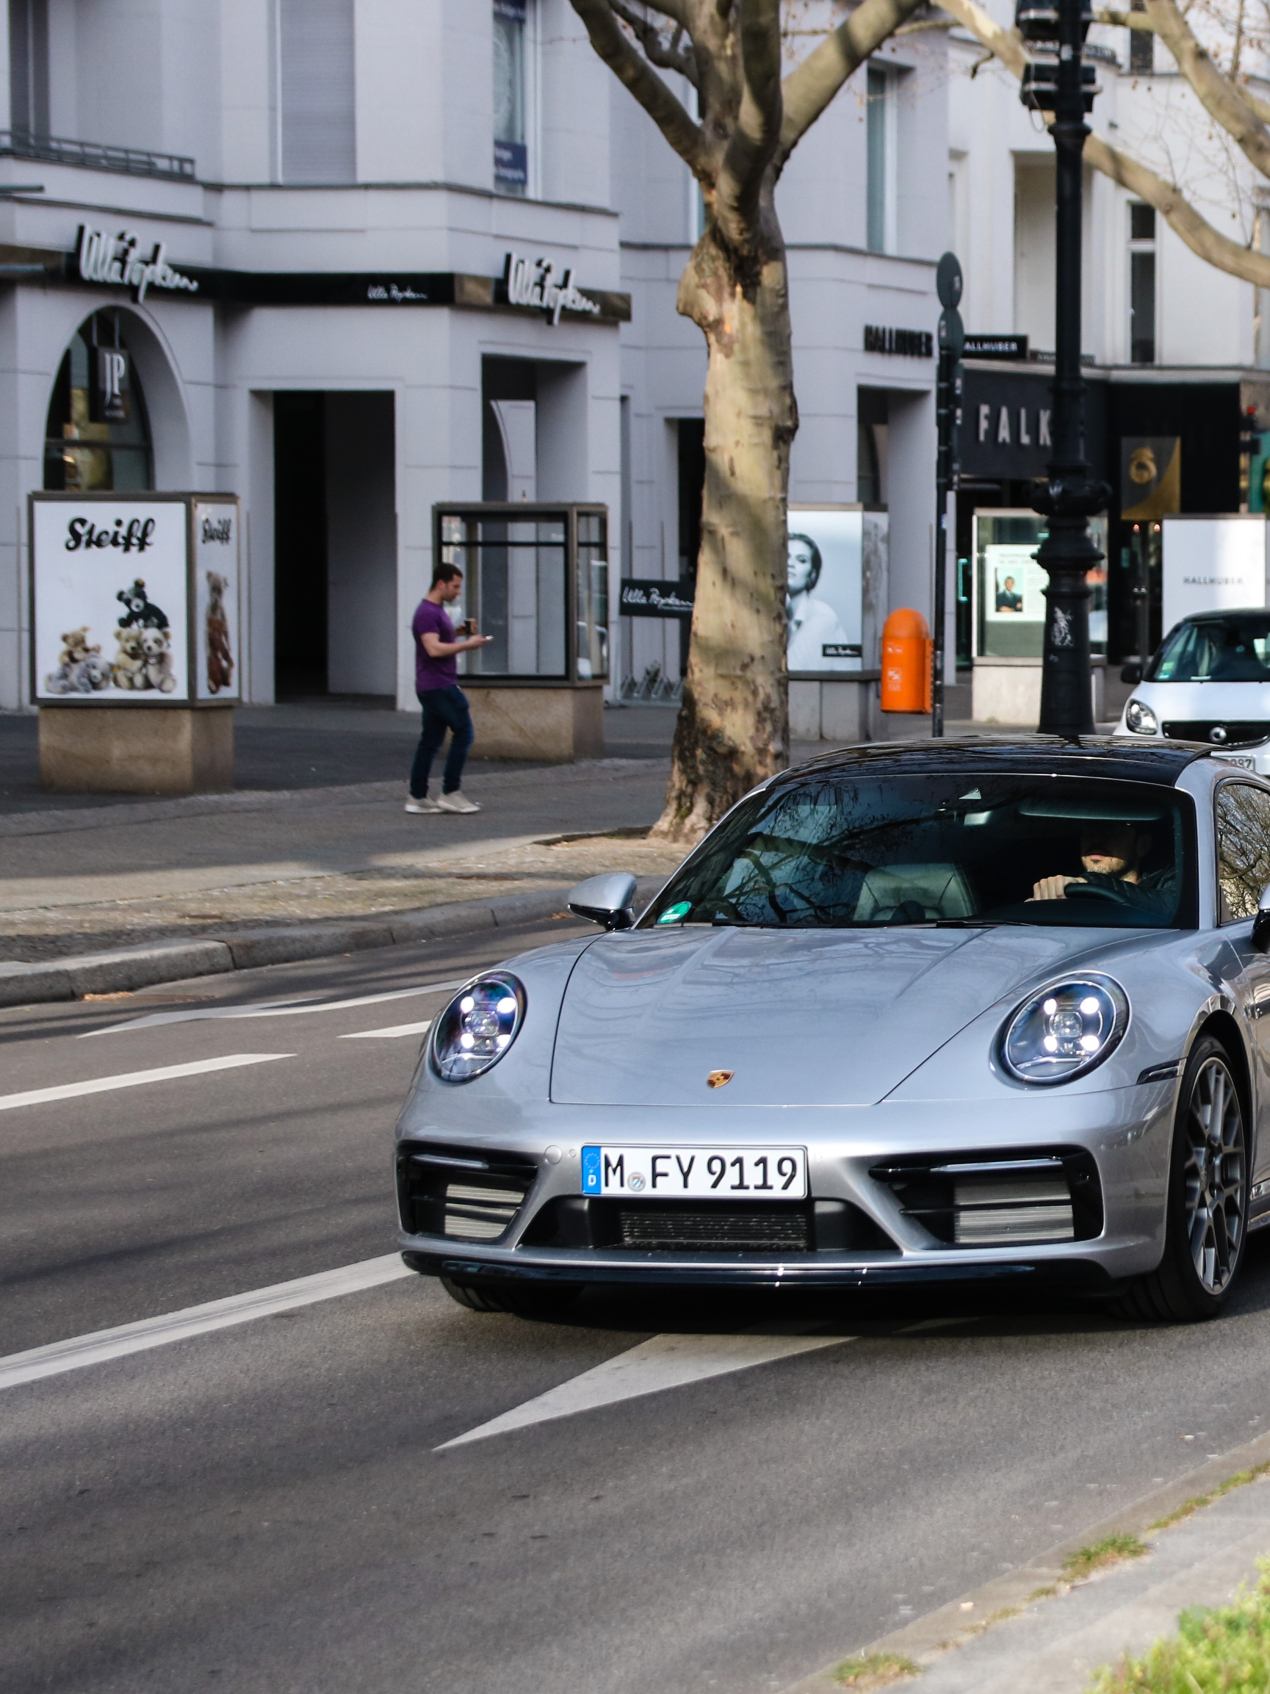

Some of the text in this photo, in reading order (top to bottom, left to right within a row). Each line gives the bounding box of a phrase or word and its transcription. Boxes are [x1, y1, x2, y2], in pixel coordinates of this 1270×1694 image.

[963, 341, 1018, 351] ALLHUBER
[104, 352, 126, 407] JP
[979, 403, 1052, 446] FALK
[64, 517, 156, 553] Steiff
[202, 517, 232, 546] Steiff
[587, 1174, 597, 1187] D
[603, 1153, 798, 1191] M FY 9119
